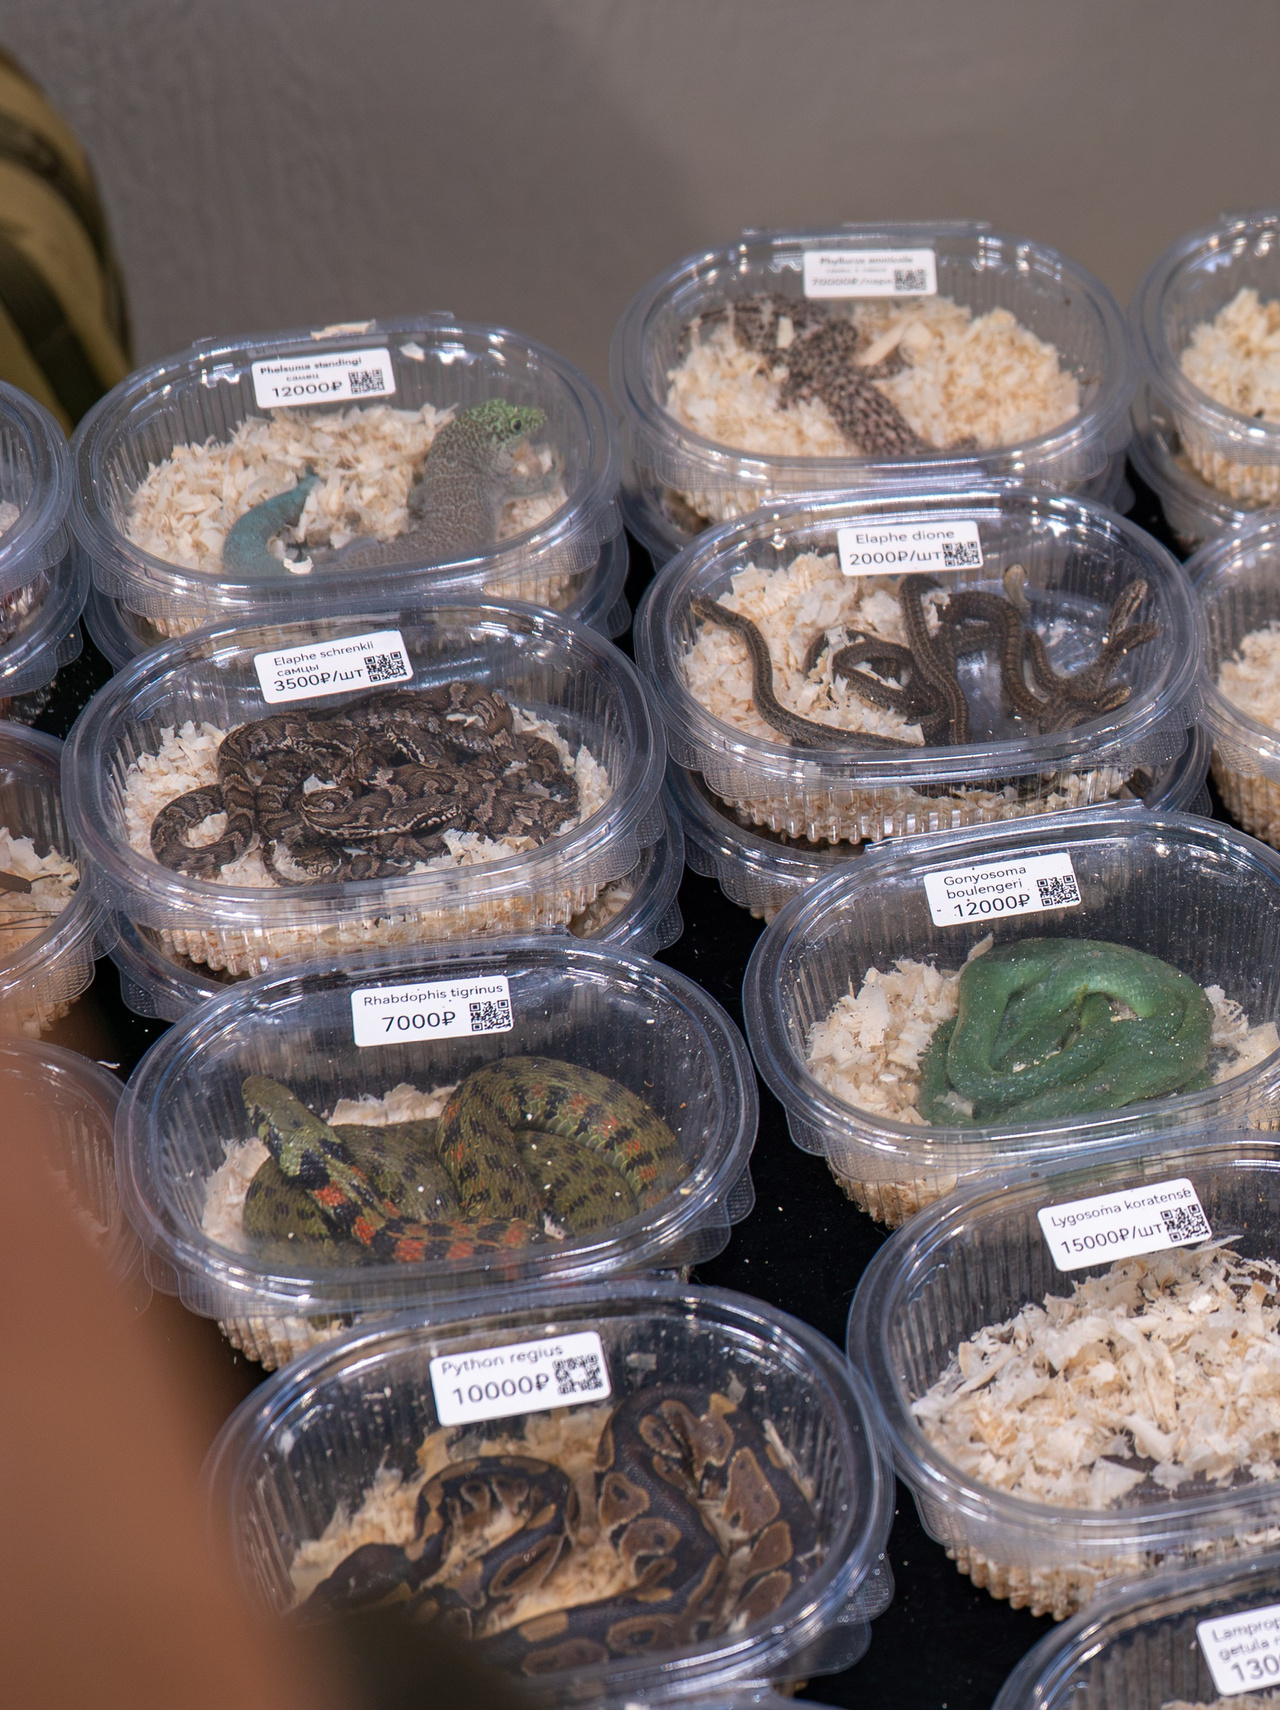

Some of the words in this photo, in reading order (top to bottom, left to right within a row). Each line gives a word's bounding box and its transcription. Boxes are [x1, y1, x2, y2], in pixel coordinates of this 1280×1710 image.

[260, 363, 311, 375] Phelsuma
[314, 357, 362, 369] standingi
[272, 382, 343, 399] 12000₽
[856, 532, 907, 546] Elaphe
[913, 529, 954, 541] dione
[850, 550, 942, 566] 2000₽/шт
[274, 651, 317, 667] Elaphe
[319, 641, 375, 658] schrenkii
[274, 668, 364, 692] 3500₽/шт
[277, 664, 319, 676] самцы
[943, 866, 1026, 887] Gonyosoma
[947, 881, 1023, 901] boulengeri
[954, 894, 1030, 917] 12000₽
[364, 988, 447, 1007] Rhabdophis
[451, 983, 503, 999] tigrinus
[382, 1011, 456, 1033] 7000₽
[1051, 1204, 1122, 1229] Lygosoma
[1125, 1188, 1191, 1211] koratense
[1061, 1222, 1163, 1254] 15000₽/шт
[441, 1357, 506, 1376] Python
[509, 1344, 564, 1365] regius
[453, 1373, 549, 1405] 10000₽
